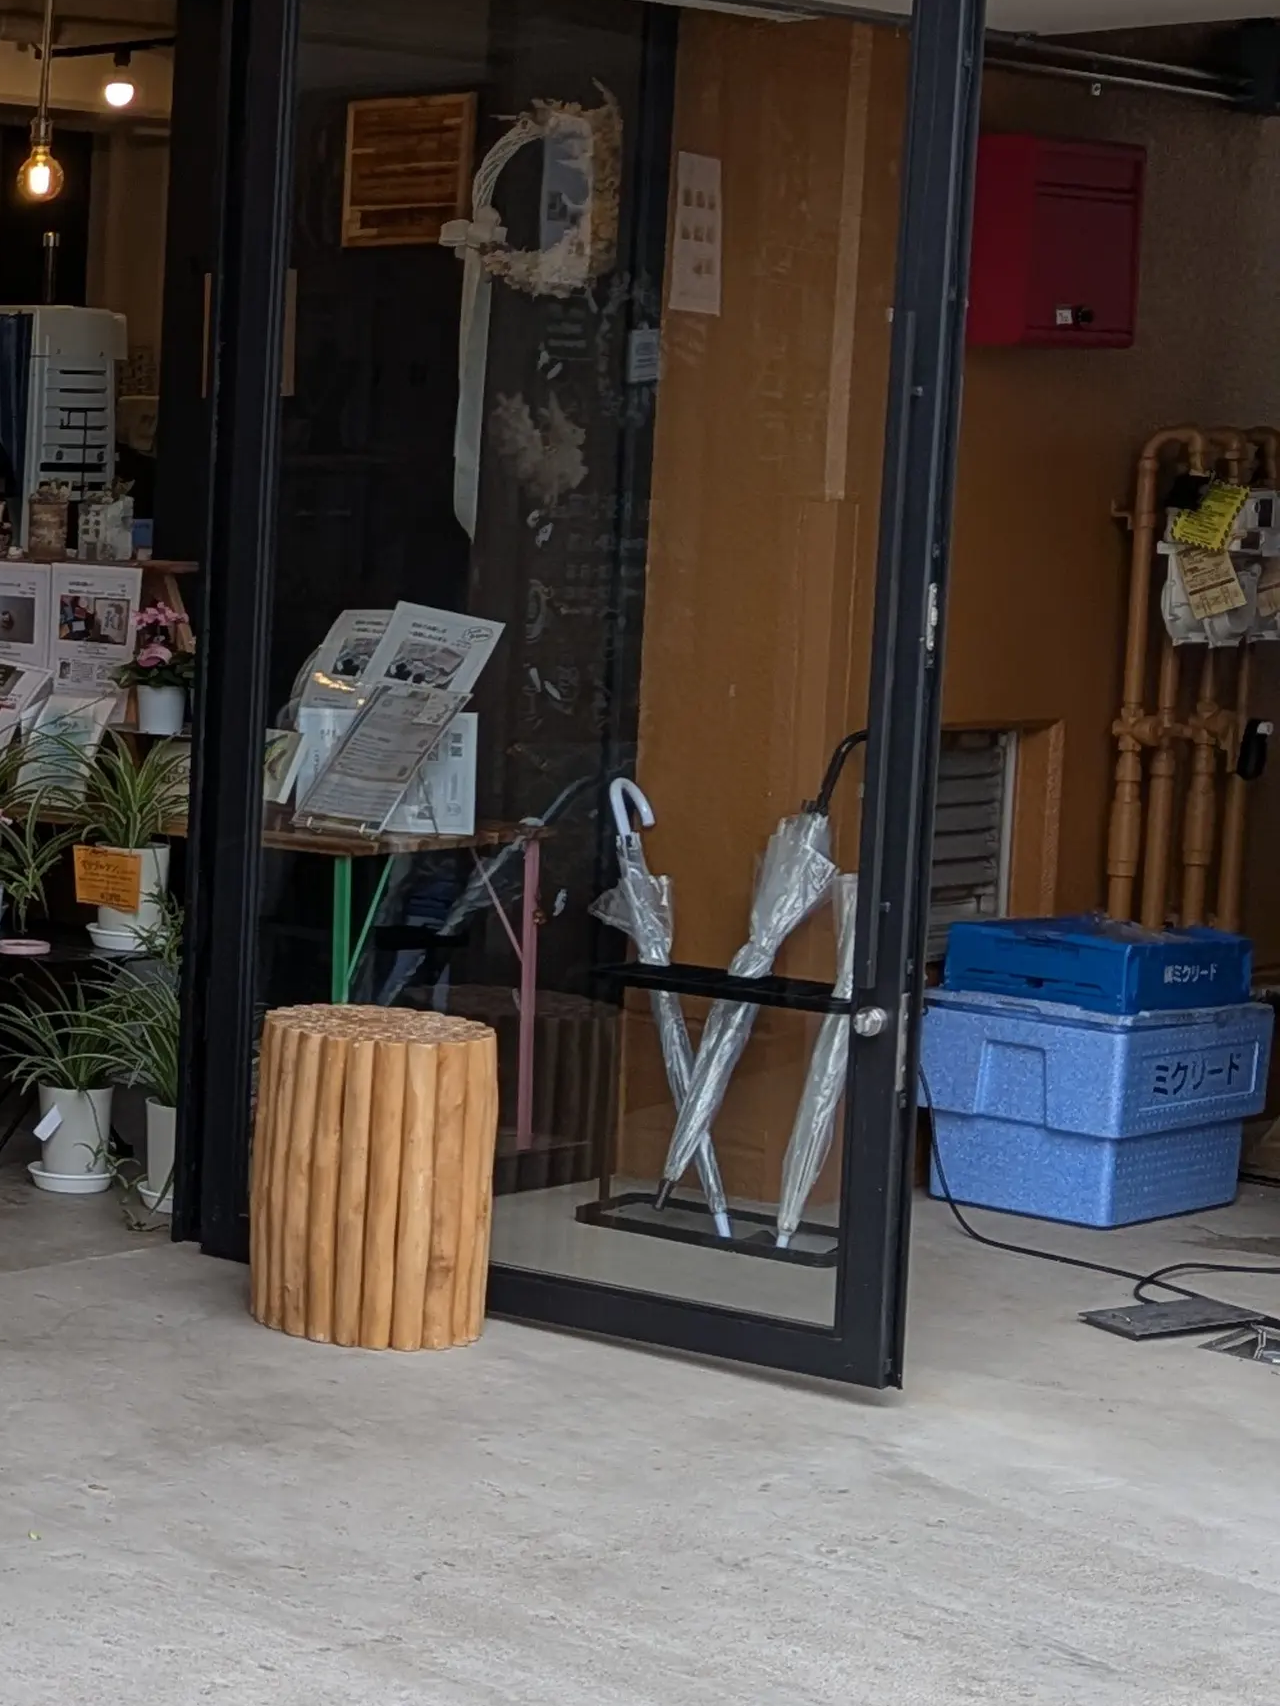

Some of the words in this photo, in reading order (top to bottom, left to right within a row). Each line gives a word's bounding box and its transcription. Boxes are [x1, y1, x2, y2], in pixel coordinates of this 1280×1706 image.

[1152, 1052, 1243, 1096] ミクリード
